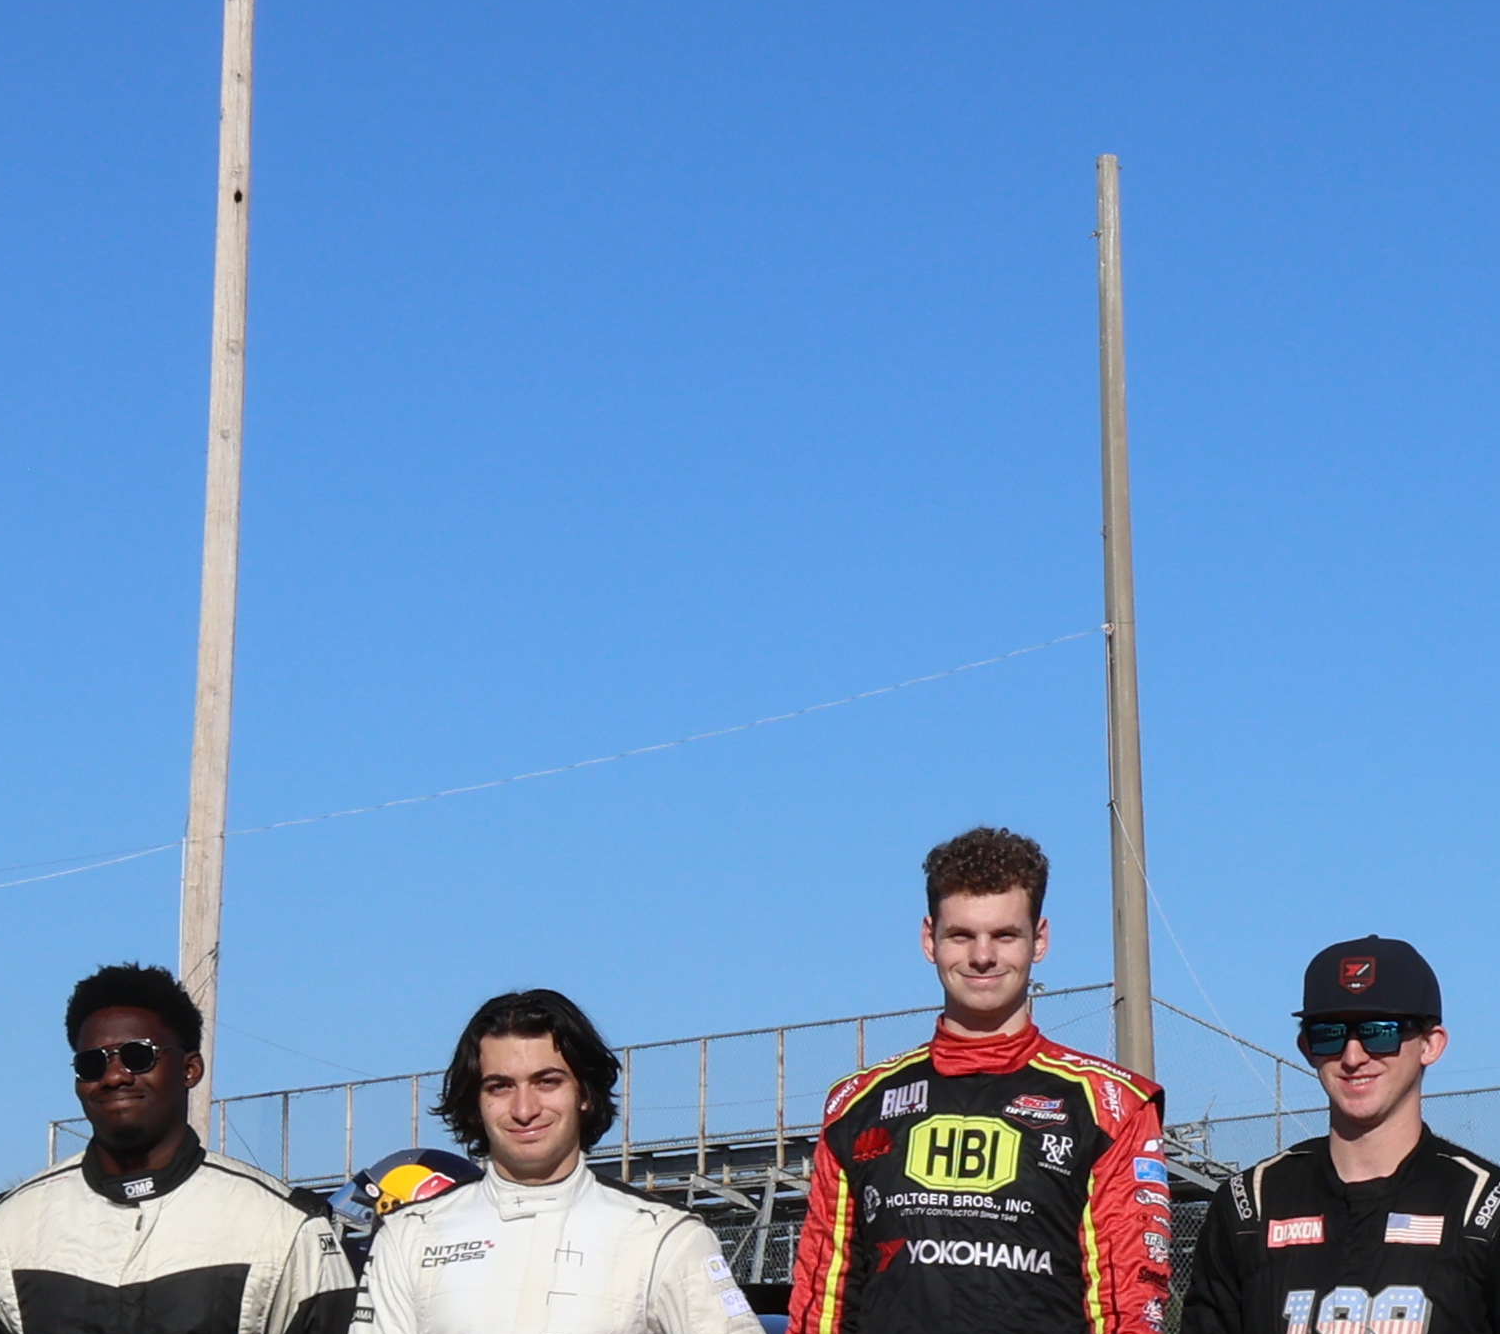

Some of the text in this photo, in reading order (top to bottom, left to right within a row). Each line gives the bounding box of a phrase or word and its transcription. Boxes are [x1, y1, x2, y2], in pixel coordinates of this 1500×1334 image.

[926, 1127, 1000, 1180] HBI
[124, 1183, 155, 1197] OMP
[885, 1193, 949, 1209] HOLTGER
[1005, 1199, 1035, 1215] INC.
[1273, 1220, 1323, 1243] DIXXON
[421, 1251, 486, 1268] CROSS
[424, 1241, 482, 1256] NITRO
[906, 1238, 1053, 1275] YOKOHAMA
